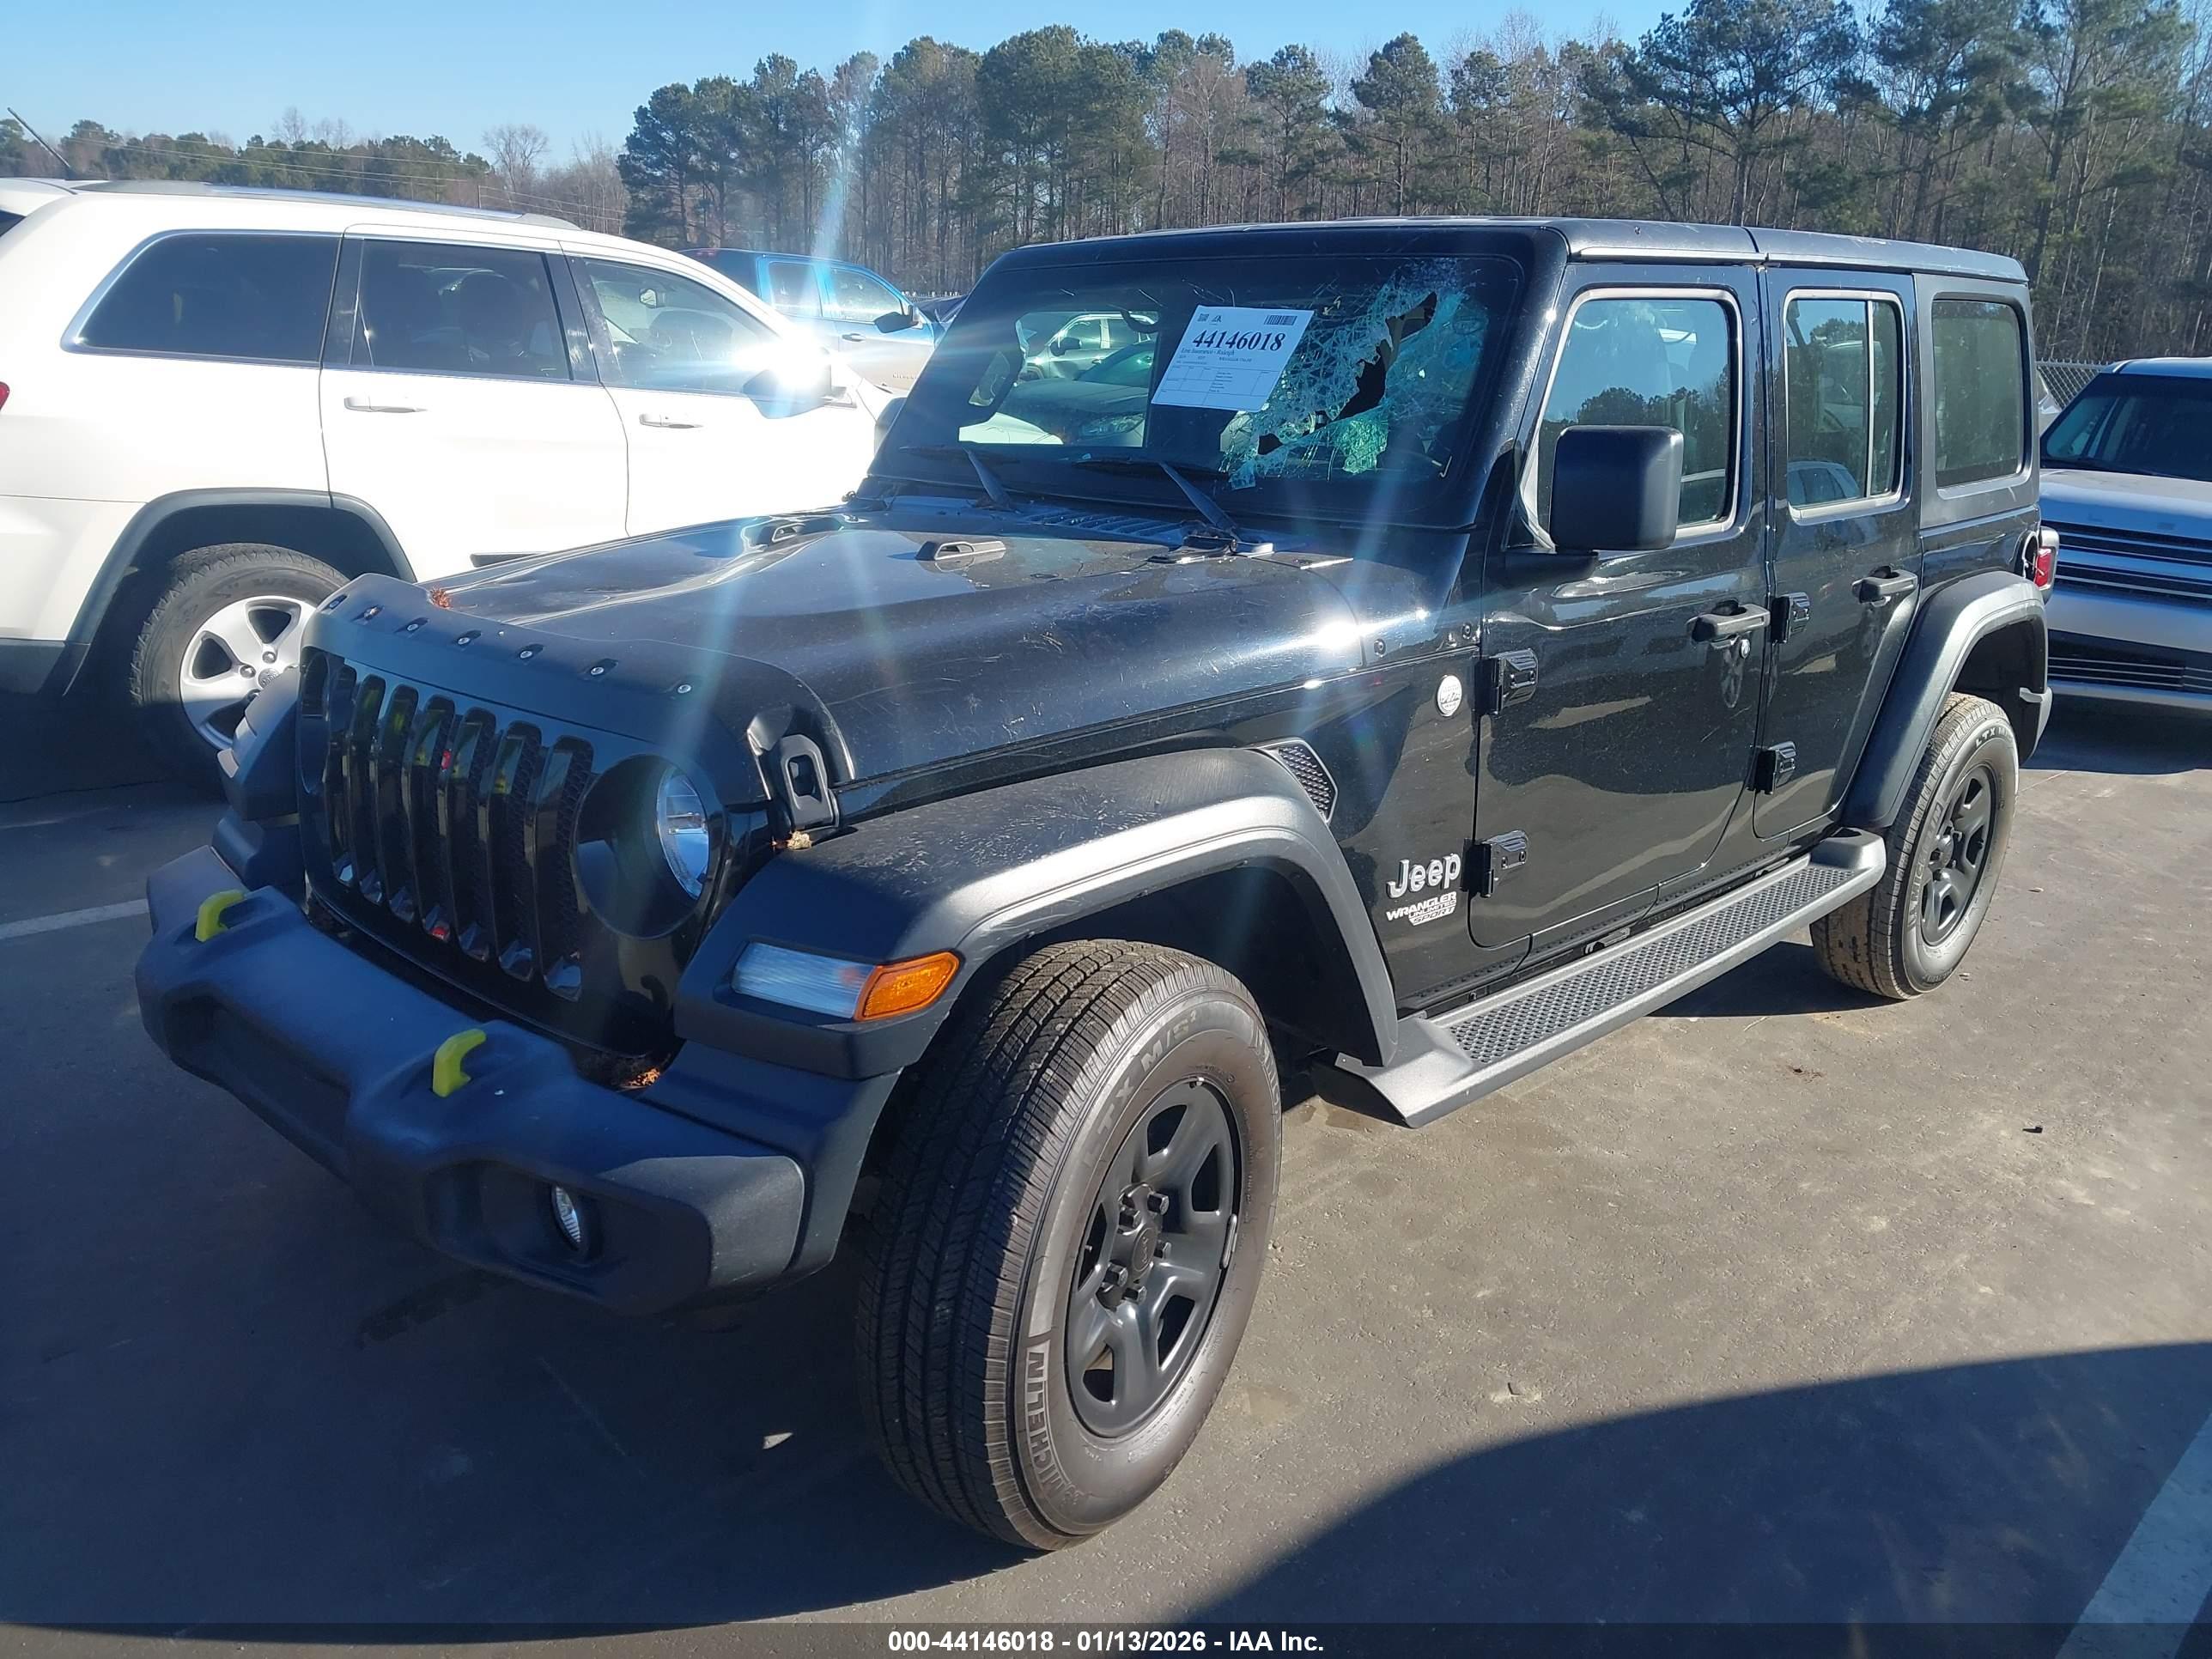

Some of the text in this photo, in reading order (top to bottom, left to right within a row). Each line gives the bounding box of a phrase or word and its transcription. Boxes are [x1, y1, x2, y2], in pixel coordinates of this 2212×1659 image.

[1192, 329, 1287, 352] 44146018
[1385, 853, 1462, 899] Jeep
[1386, 890, 1457, 921] WRANGLER
[1409, 900, 1456, 919] UNLIMITED
[1413, 907, 1455, 924] SPORT
[1025, 1350, 1065, 1499] MICHELIN
